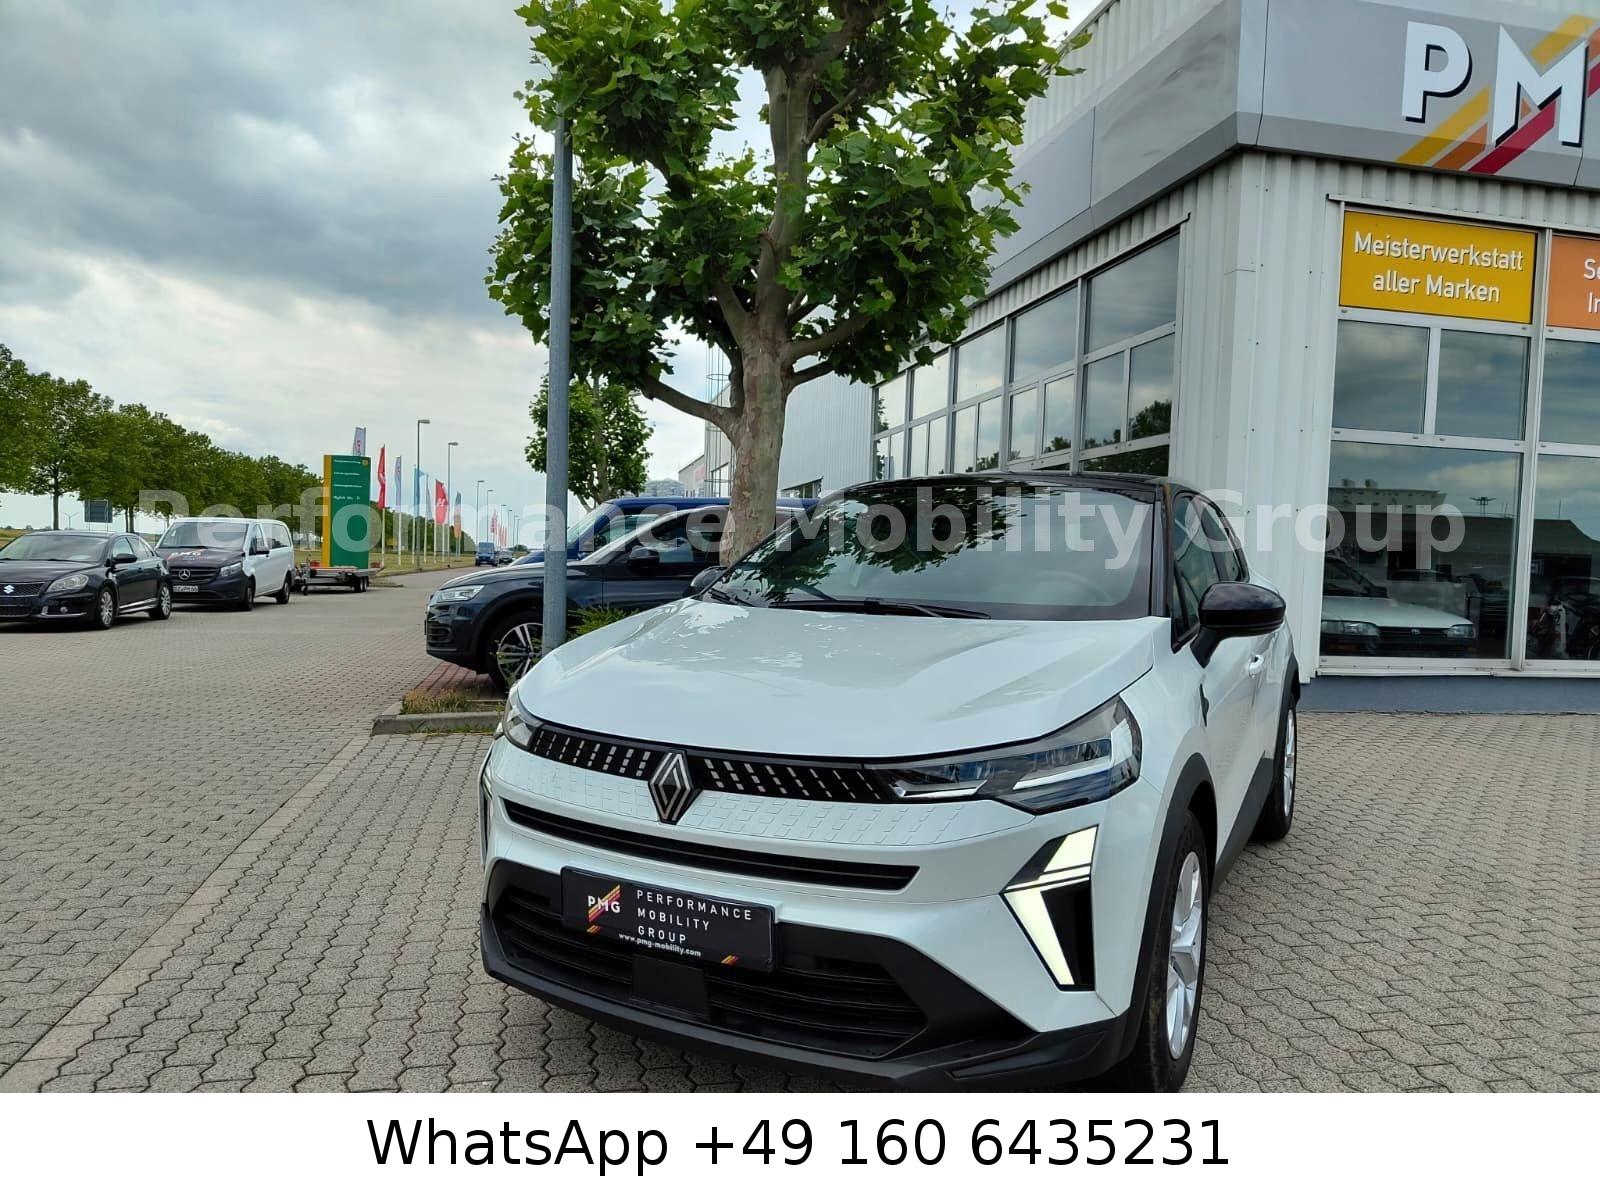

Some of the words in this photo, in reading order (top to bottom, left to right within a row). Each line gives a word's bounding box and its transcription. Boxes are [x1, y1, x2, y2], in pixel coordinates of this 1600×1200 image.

[1354, 231, 1524, 271] Meisterwerkstatt
[1373, 270, 1420, 294] aller
[1426, 274, 1500, 303] Marken
[587, 895, 621, 913] PMG
[637, 890, 752, 920] PERFORMANCE
[637, 907, 710, 931] MOBILITY
[619, 933, 702, 957] www.pmg-mobility.com
[638, 925, 686, 944] GROUP
